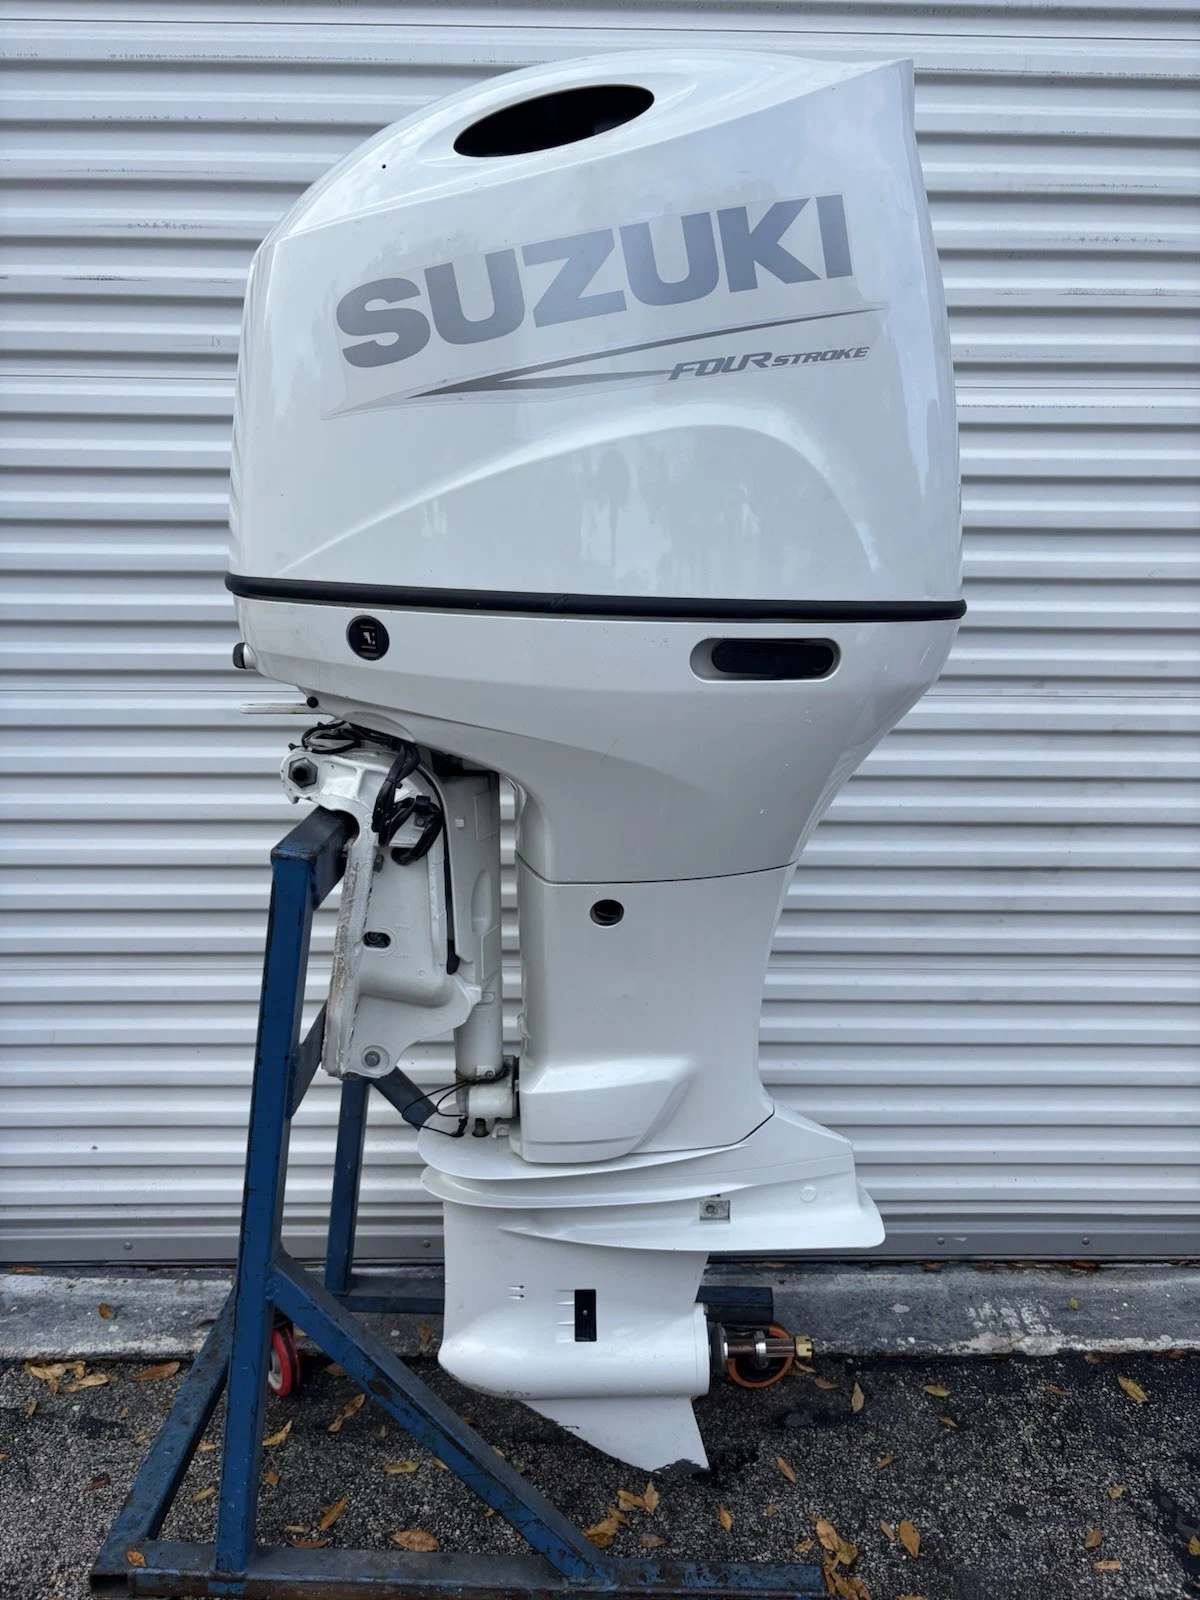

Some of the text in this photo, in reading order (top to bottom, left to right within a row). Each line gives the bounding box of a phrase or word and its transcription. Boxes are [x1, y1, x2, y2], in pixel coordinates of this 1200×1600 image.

[336, 194, 853, 368] SUZUKI
[668, 346, 870, 381] FOUR STROKE
